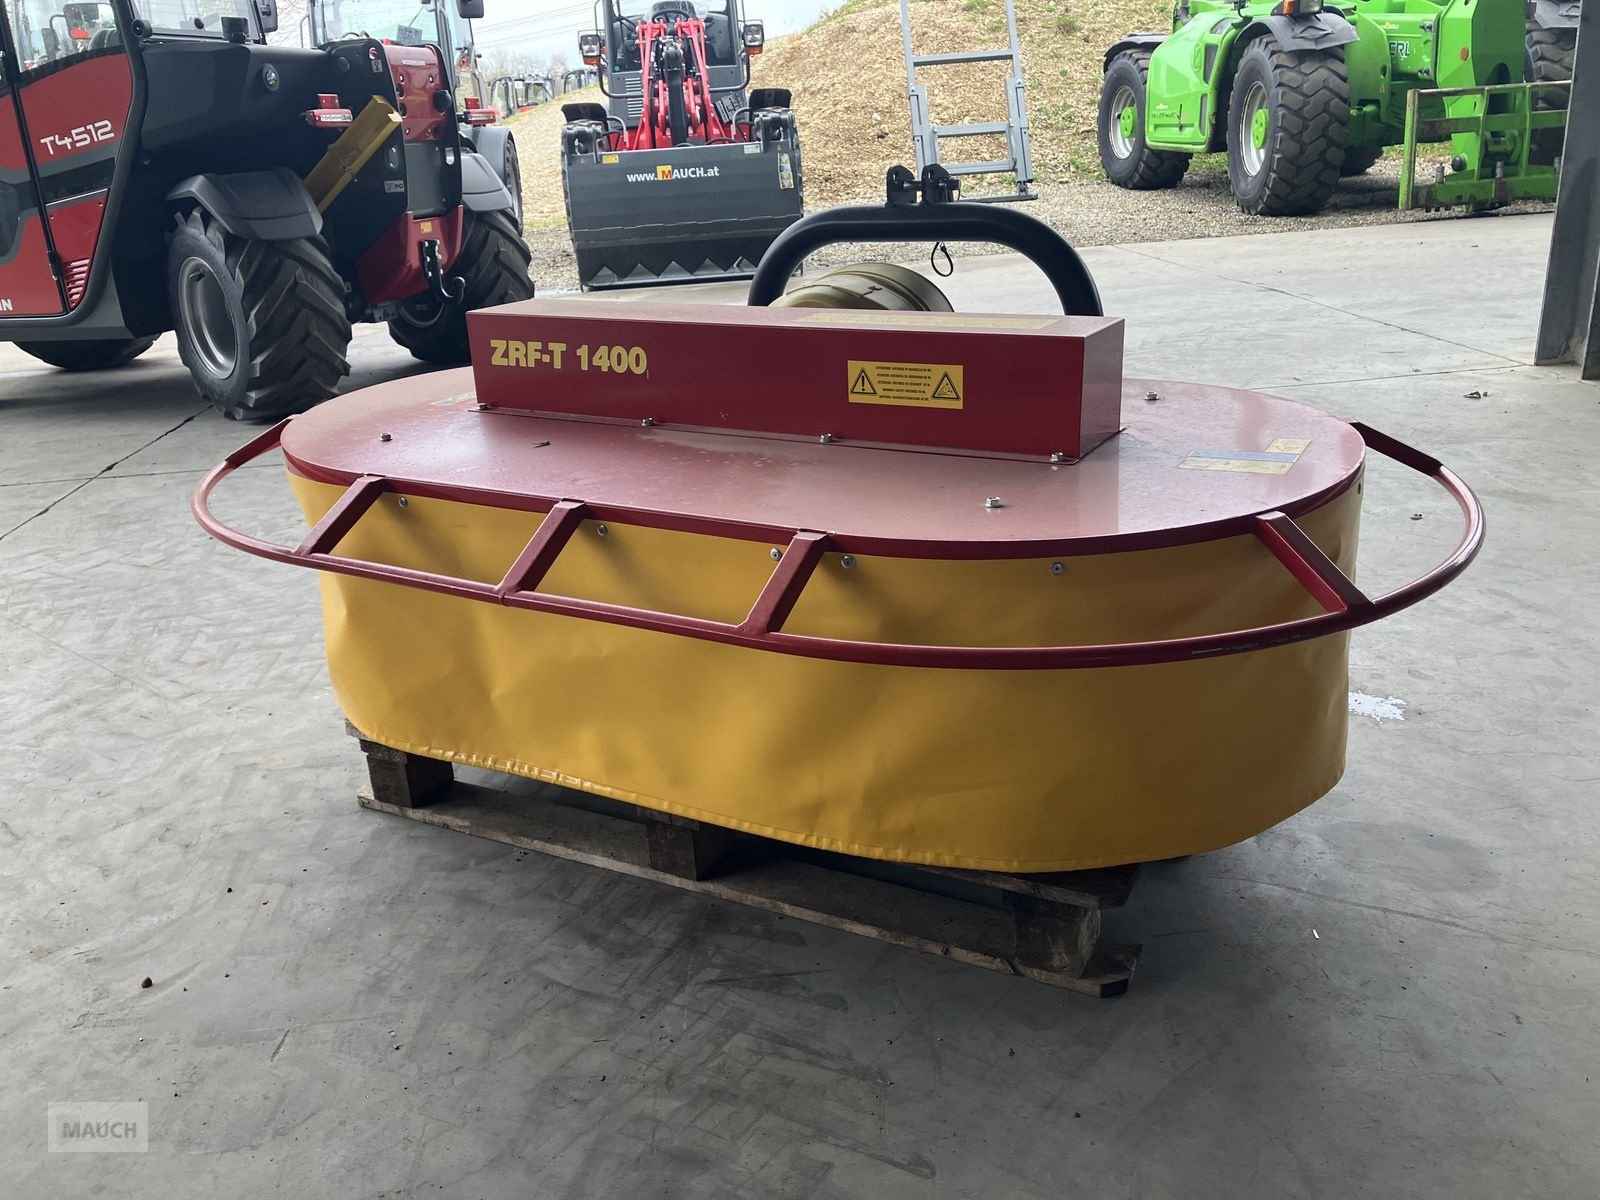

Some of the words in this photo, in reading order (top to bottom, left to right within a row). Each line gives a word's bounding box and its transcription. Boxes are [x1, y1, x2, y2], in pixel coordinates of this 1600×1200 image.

[40, 120, 115, 155] T4512
[627, 166, 719, 182] www.MAUCH.at
[490, 340, 566, 369] ZRF-T
[576, 345, 647, 374] 1400
